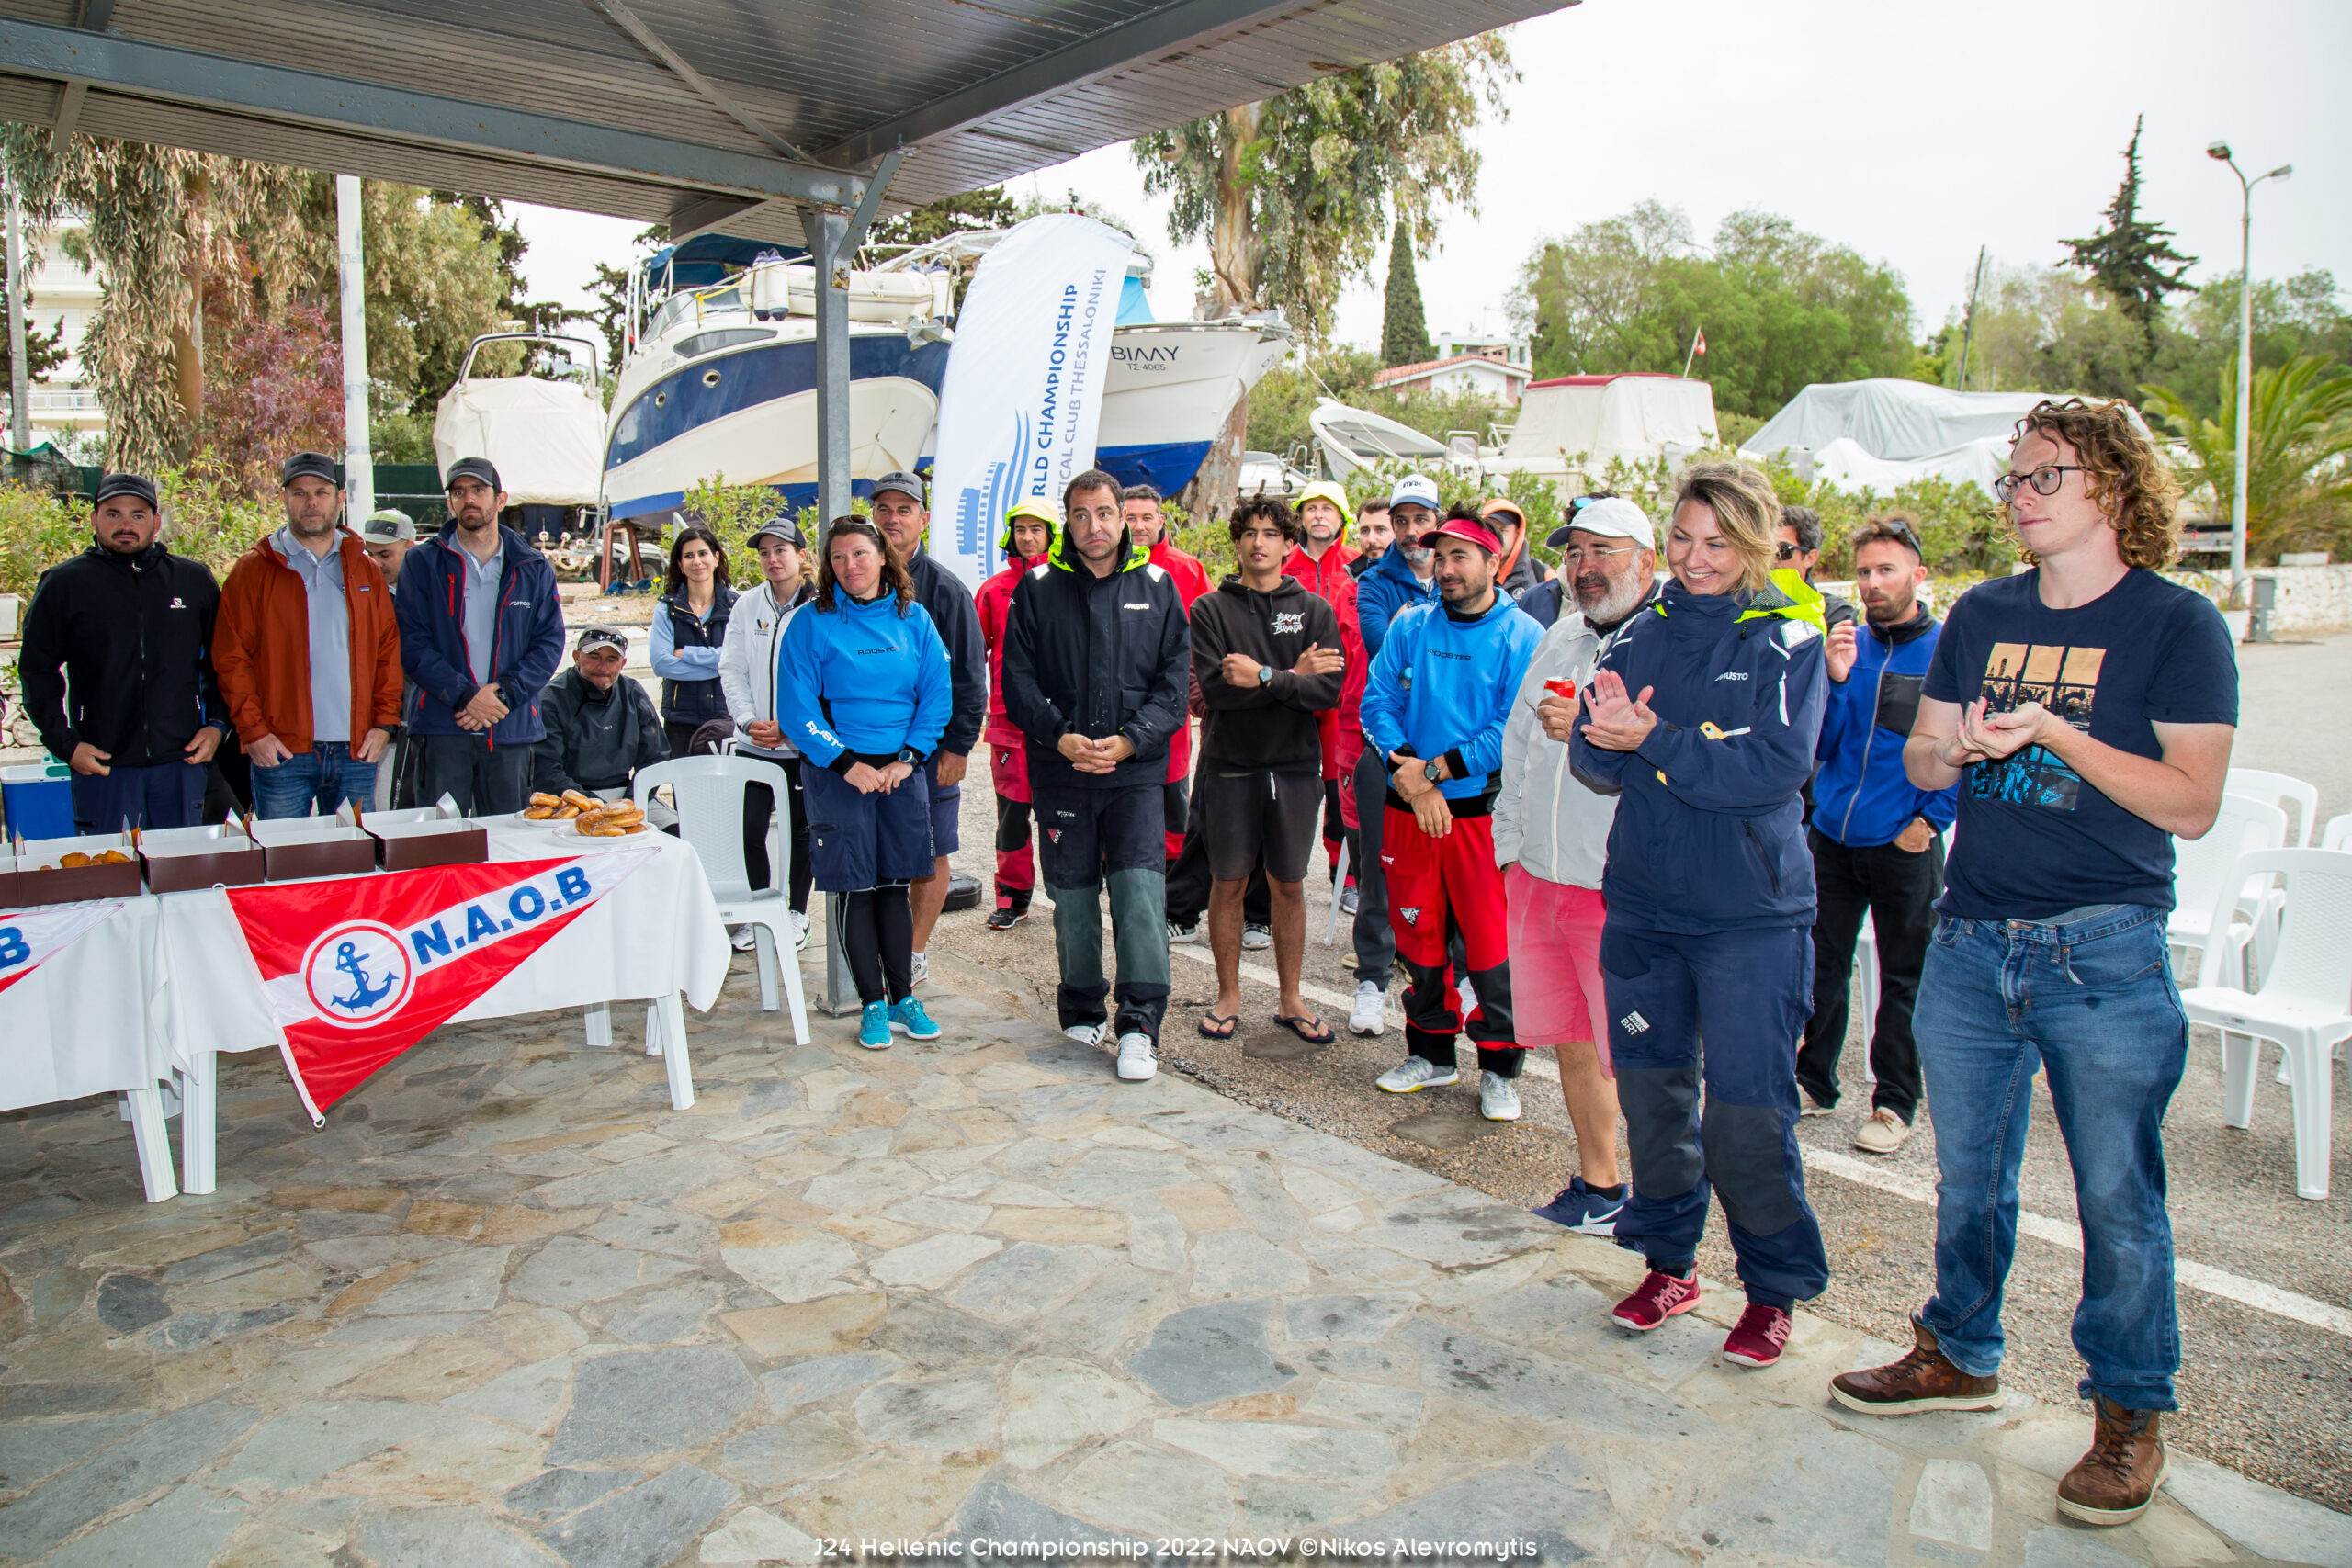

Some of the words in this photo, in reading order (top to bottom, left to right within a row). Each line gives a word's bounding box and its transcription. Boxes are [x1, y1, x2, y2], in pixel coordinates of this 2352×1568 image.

[1070, 269, 1106, 396] THESSALONIKI
[1037, 284, 1078, 449] CHAMPIONSHIP
[1142, 363, 1166, 371] 4065
[1064, 400, 1080, 444] CLUB
[1031, 456, 1048, 496] RLD
[1276, 612, 1305, 624] BRAT
[1714, 671, 1749, 682] MUSTO
[1053, 829, 1063, 844] MPX
[410, 866, 592, 965] N.A.O.B
[1408, 908, 1419, 925] MPX
[1620, 1017, 1638, 1035] BR1
